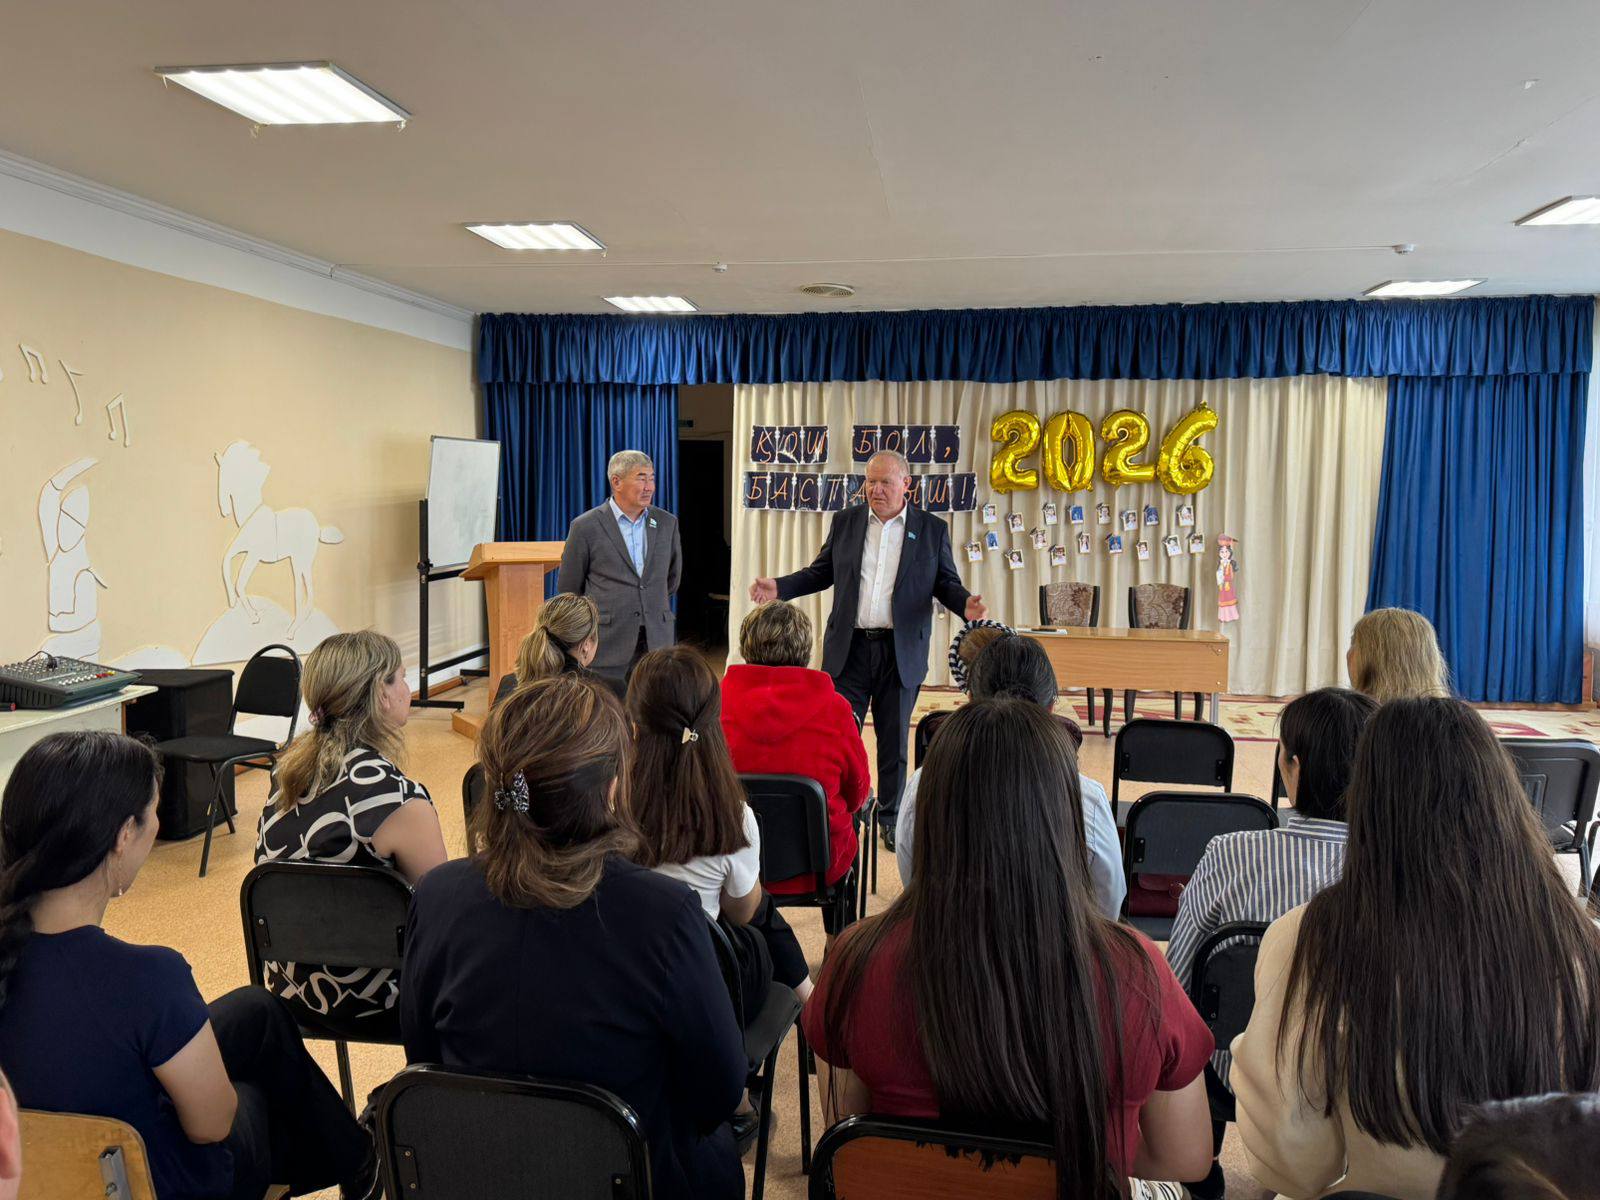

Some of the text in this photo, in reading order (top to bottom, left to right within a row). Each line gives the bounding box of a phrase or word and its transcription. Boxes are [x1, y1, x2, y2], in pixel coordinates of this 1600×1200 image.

[855, 429, 951, 458] БОЛ,
[990, 401, 1218, 495] 2026
[745, 475, 968, 505] БАСТАЫШ!
